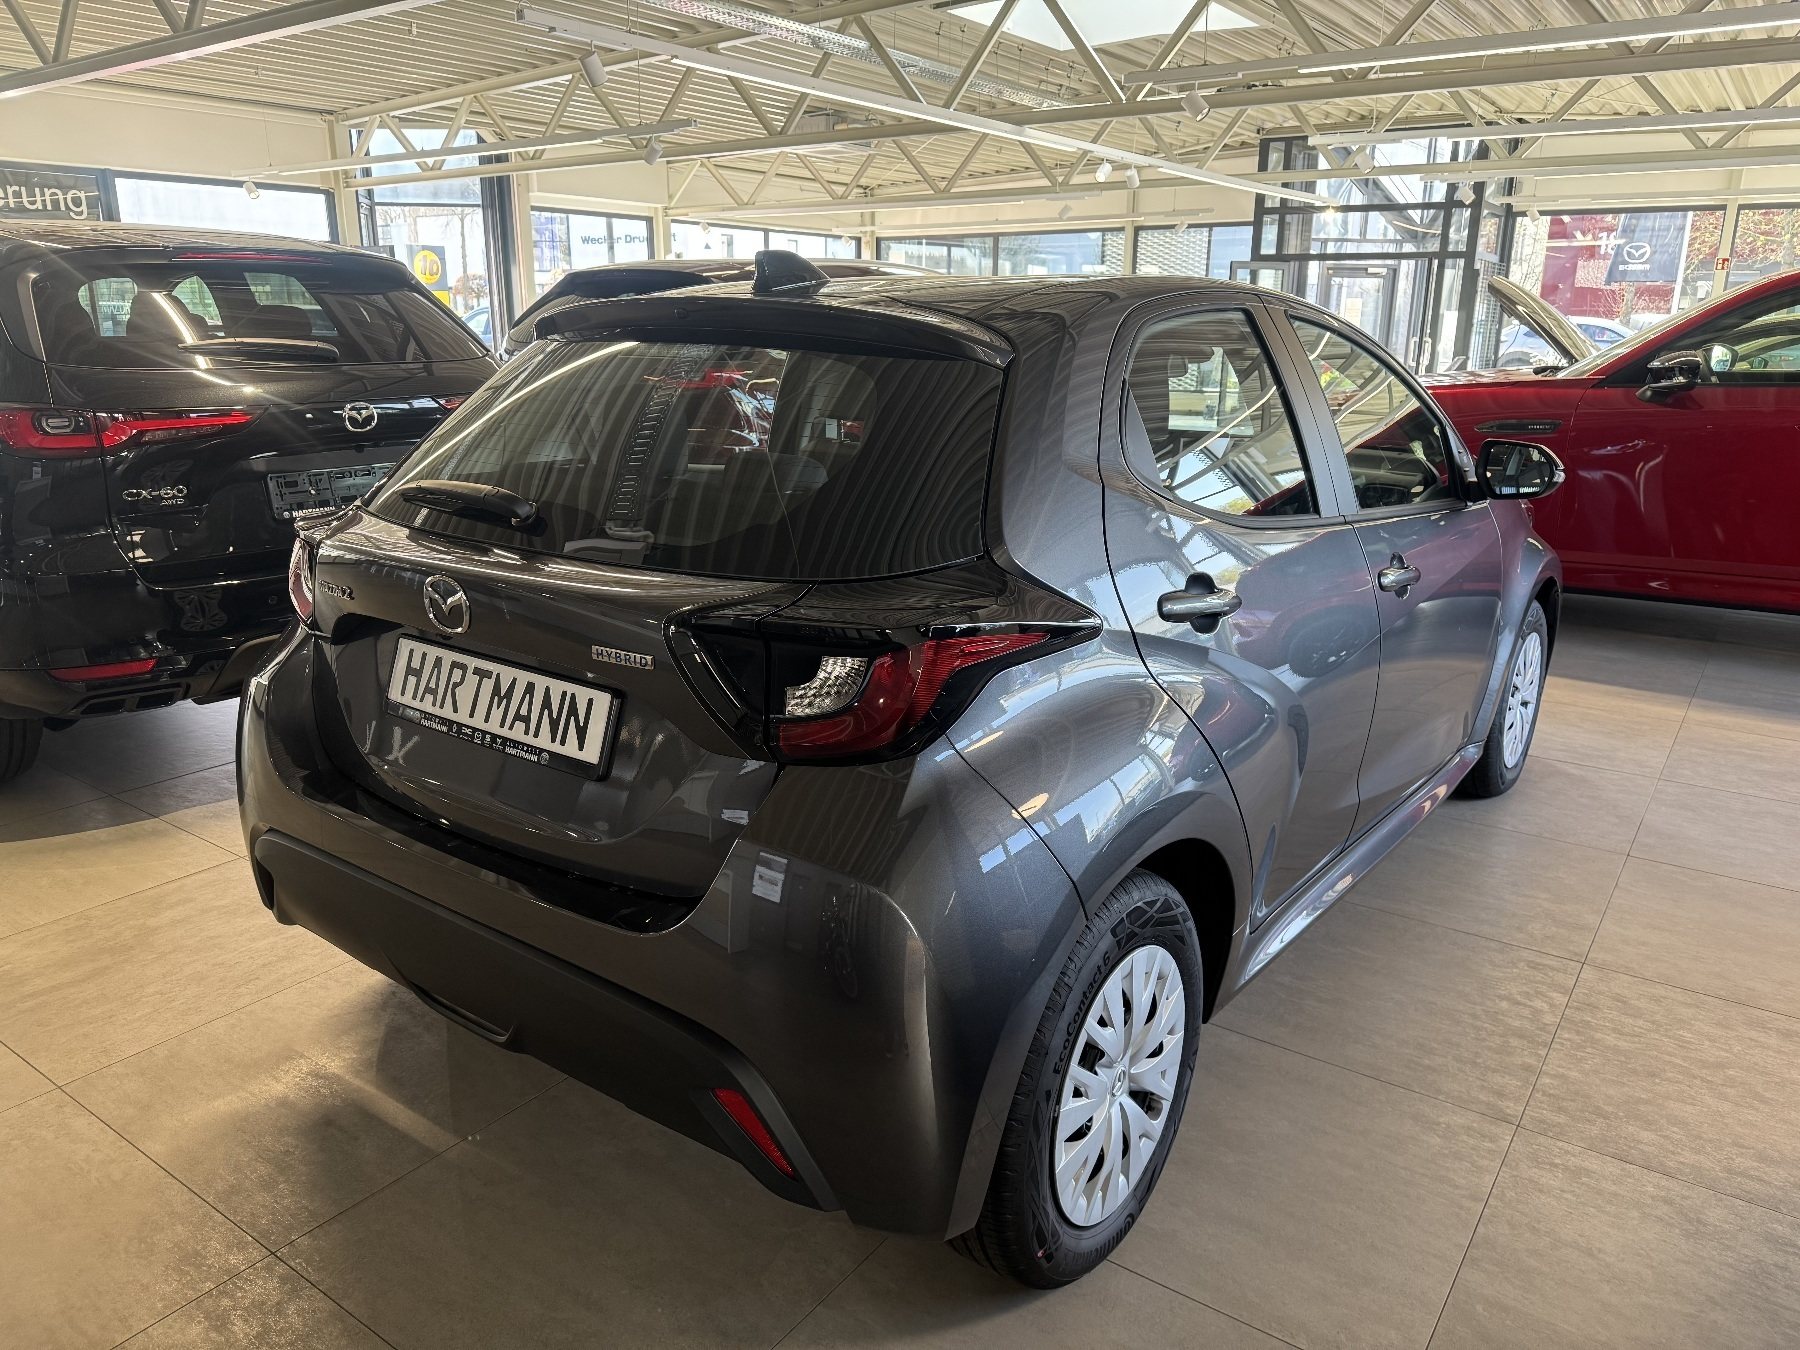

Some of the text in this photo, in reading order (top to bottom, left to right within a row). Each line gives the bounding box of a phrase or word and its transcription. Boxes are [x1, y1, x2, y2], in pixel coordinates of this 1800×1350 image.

[580, 235, 621, 245] Wecr
[122, 485, 188, 501] CX-60
[595, 647, 649, 668] HYBRID
[400, 648, 595, 752] HARTMANN
[505, 746, 539, 762] HARTMANN
[1052, 950, 1111, 1075] EcoContact 6
